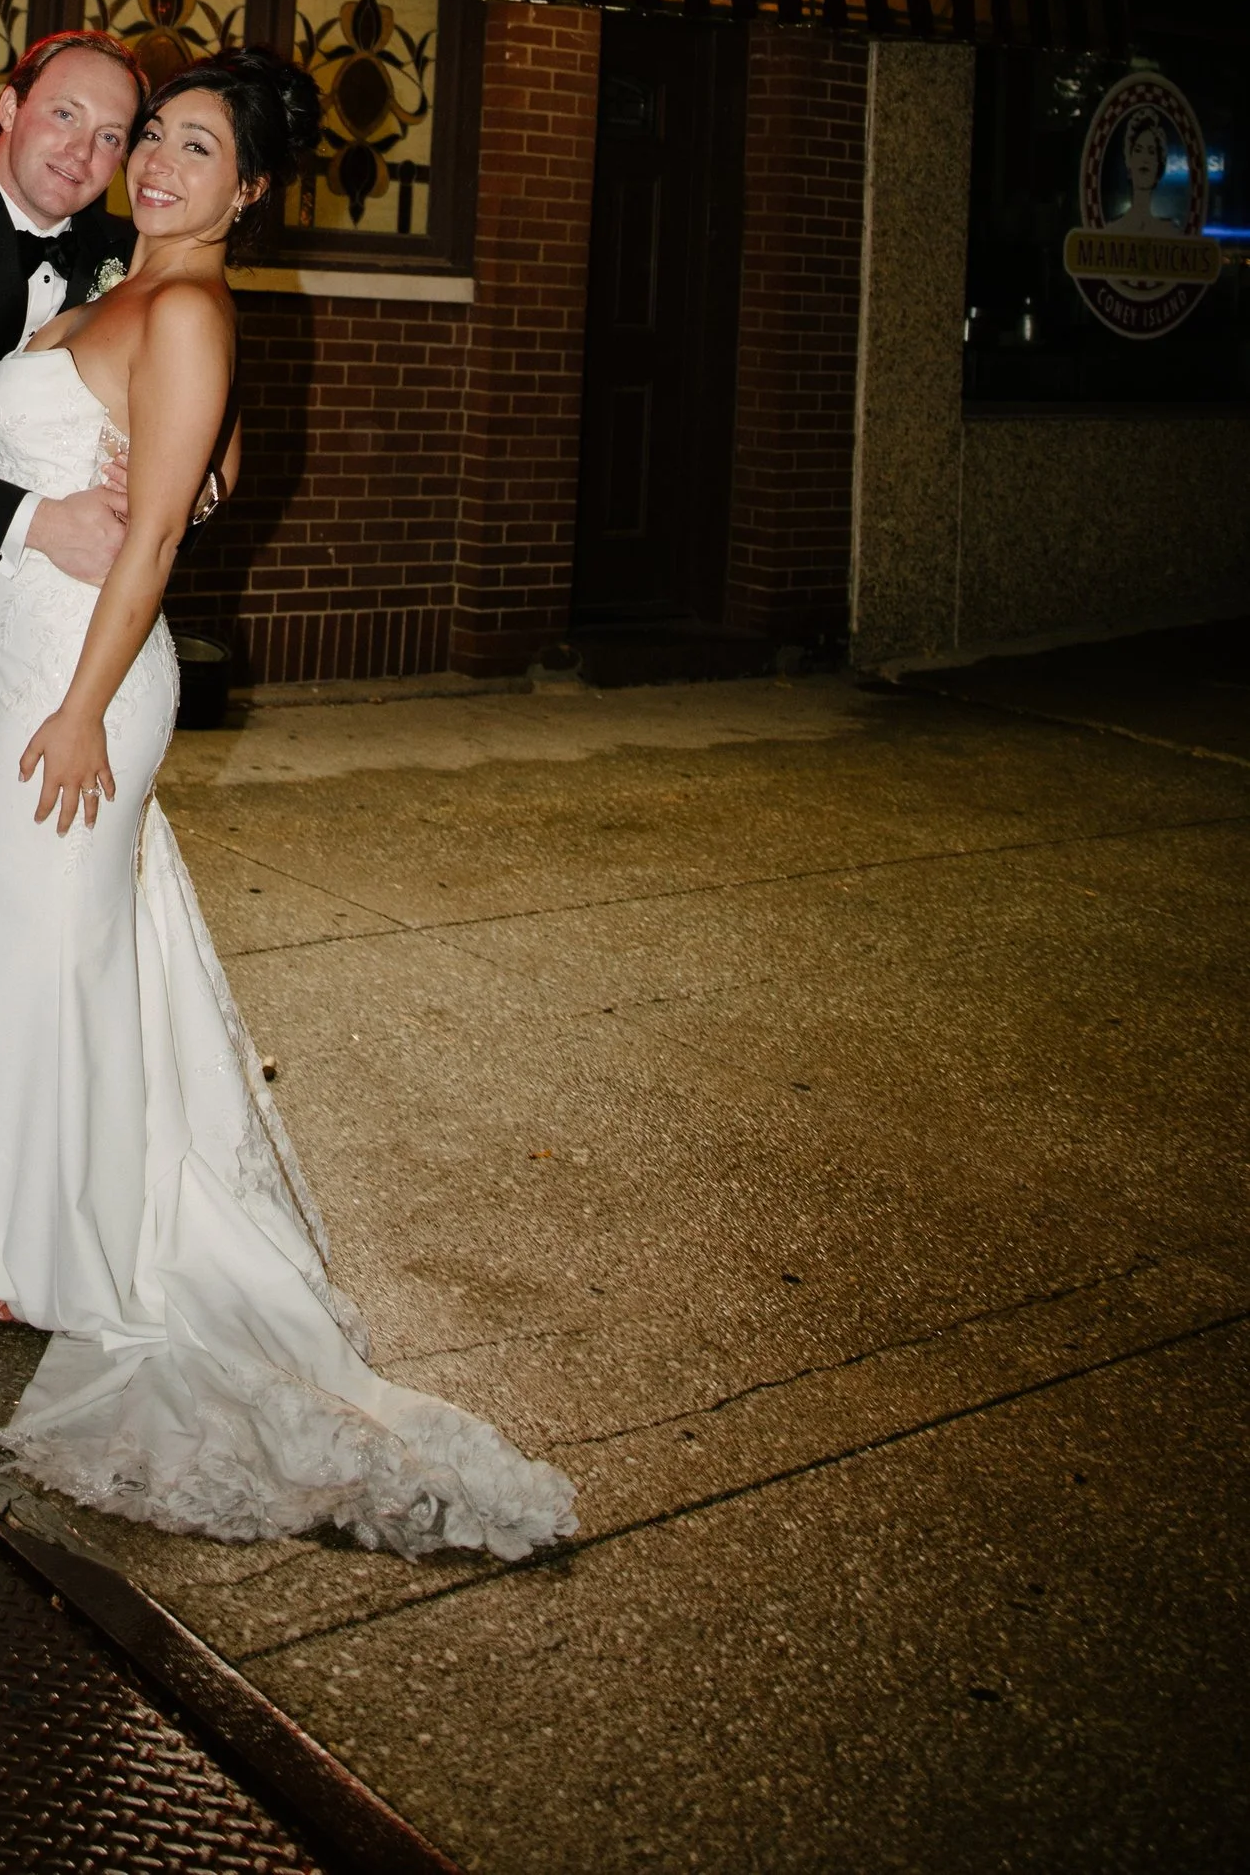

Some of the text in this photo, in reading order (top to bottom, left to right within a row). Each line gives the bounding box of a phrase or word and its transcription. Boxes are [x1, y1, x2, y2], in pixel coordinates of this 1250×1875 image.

[1077, 238, 1139, 269] MAMA
[1096, 286, 1188, 329] CONEY ISLAND
